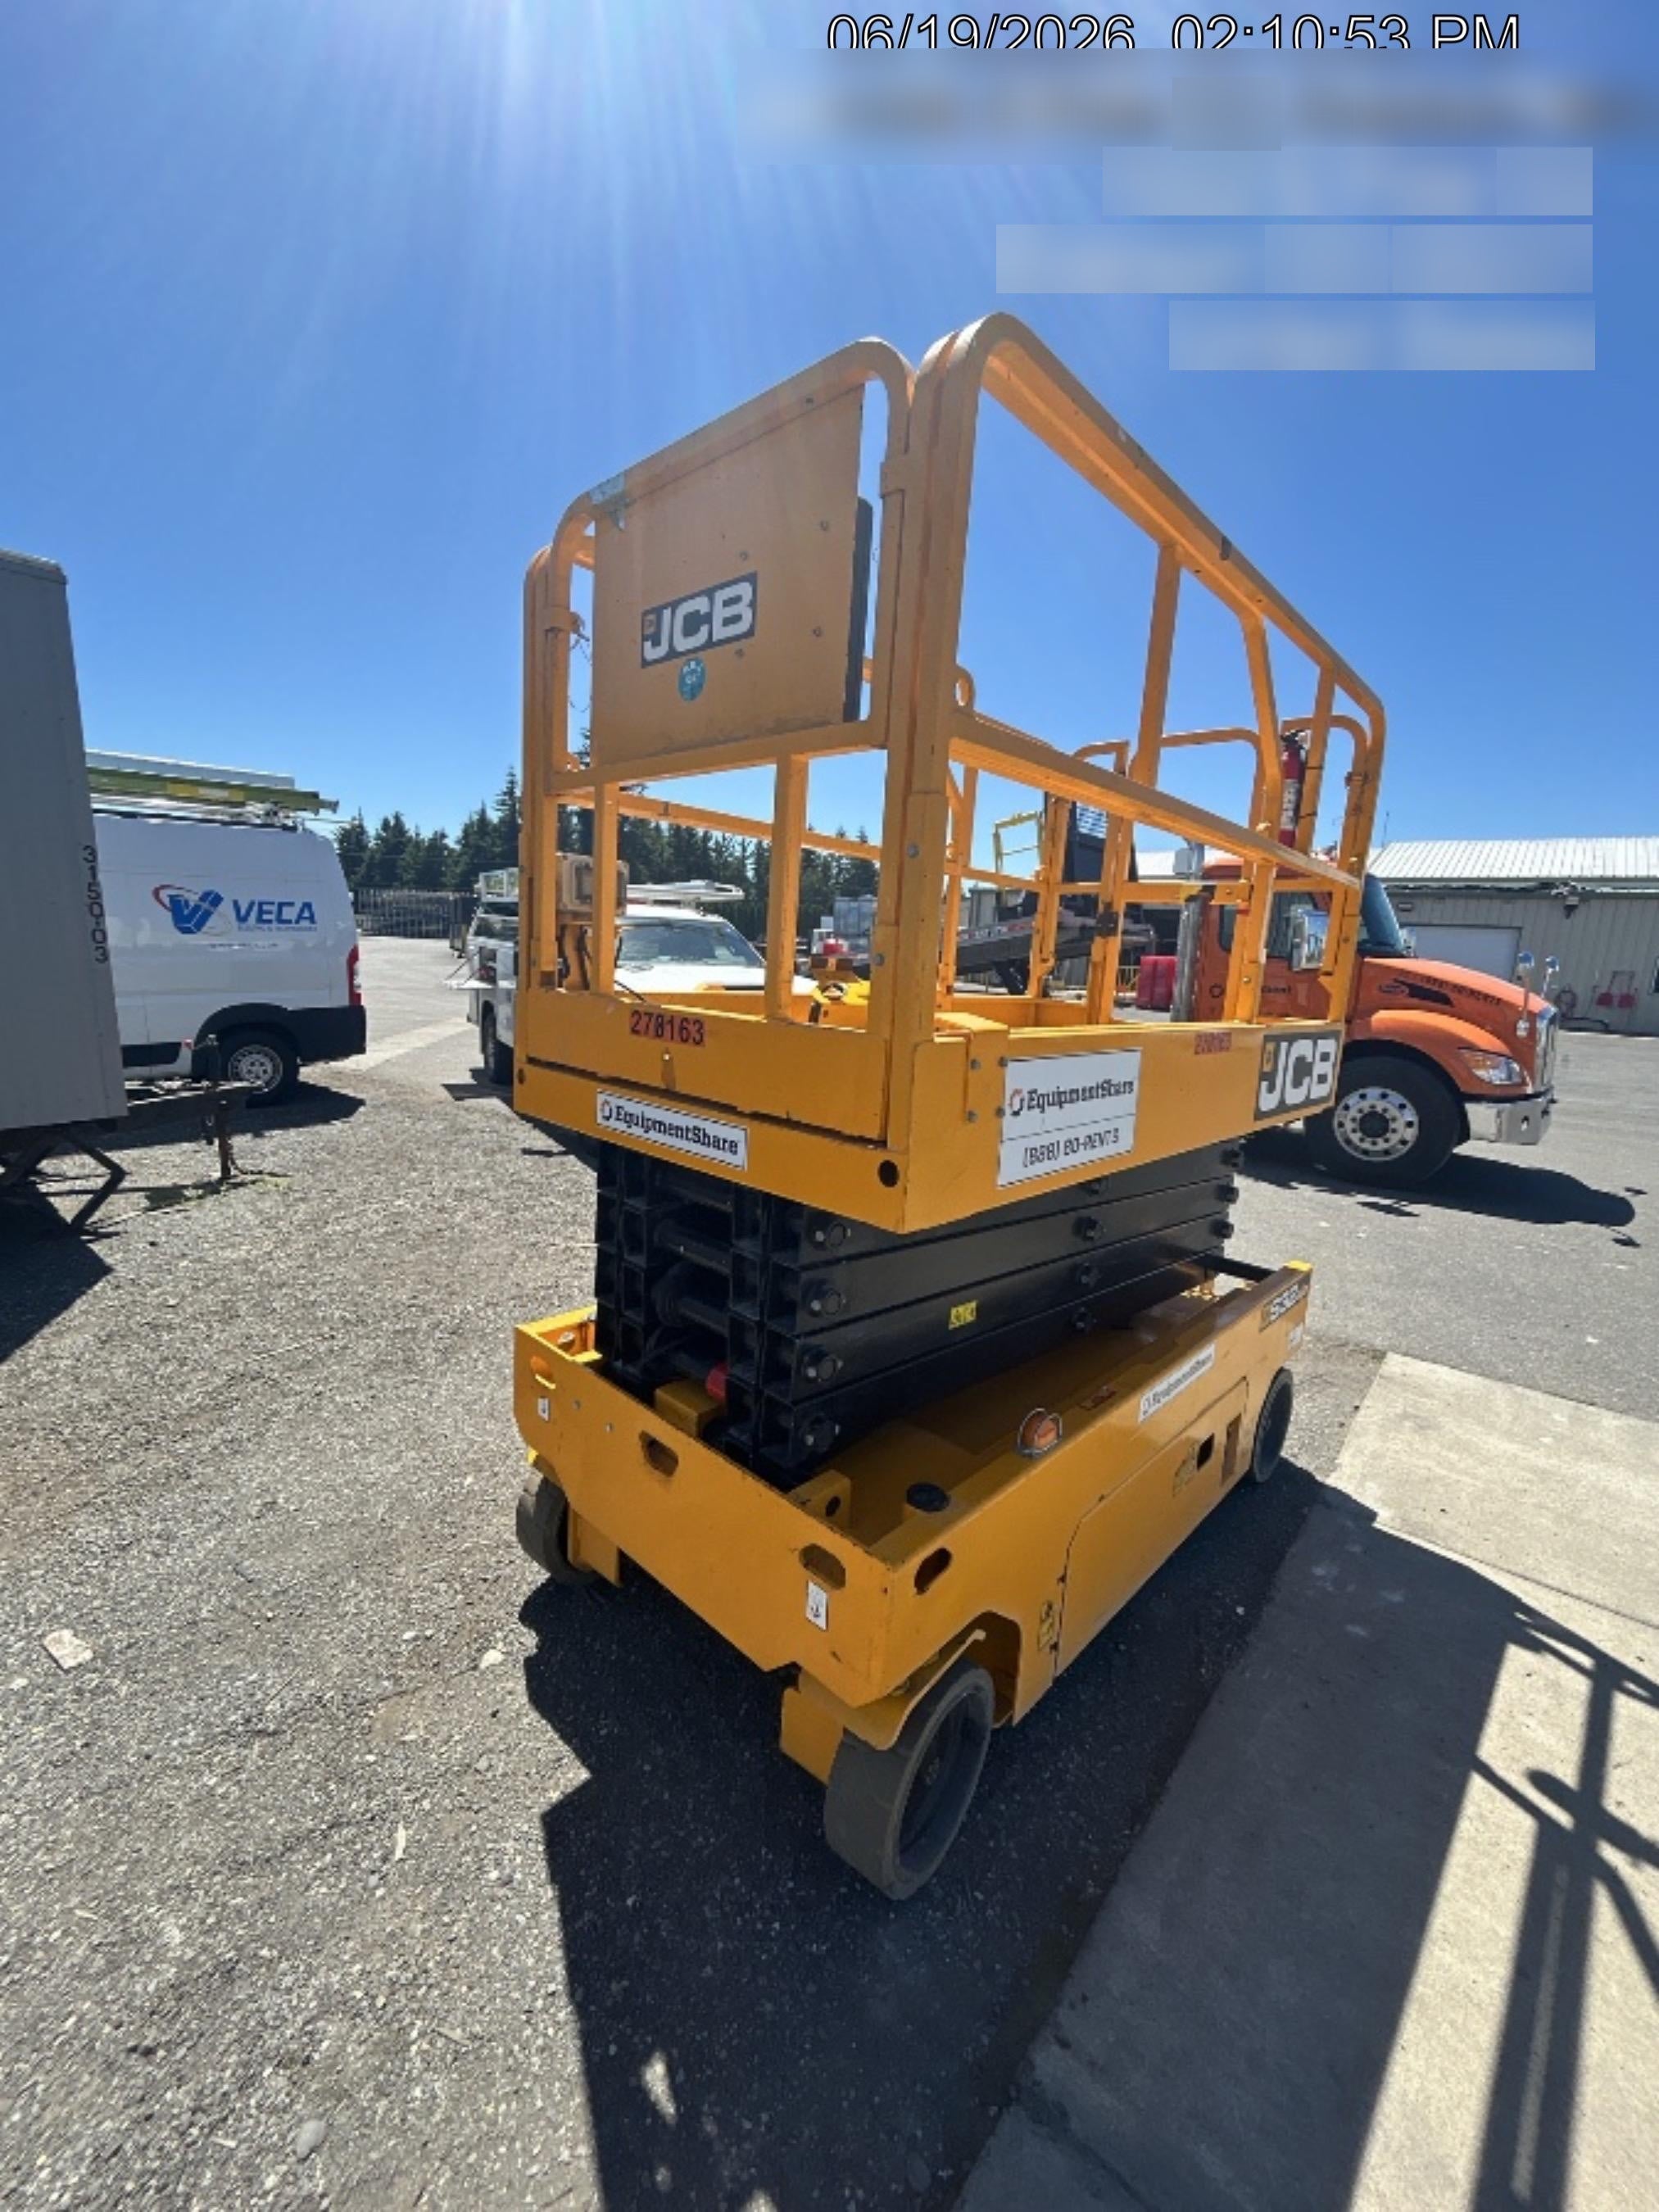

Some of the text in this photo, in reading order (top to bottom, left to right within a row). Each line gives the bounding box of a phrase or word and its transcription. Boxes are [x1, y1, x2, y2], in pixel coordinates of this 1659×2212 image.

[643, 581, 754, 662] JCB
[233, 899, 317, 925] VECA
[630, 1009, 705, 1045] 278163
[1258, 1038, 1338, 1113] JCB
[615, 1105, 738, 1156] EquipmentShare
